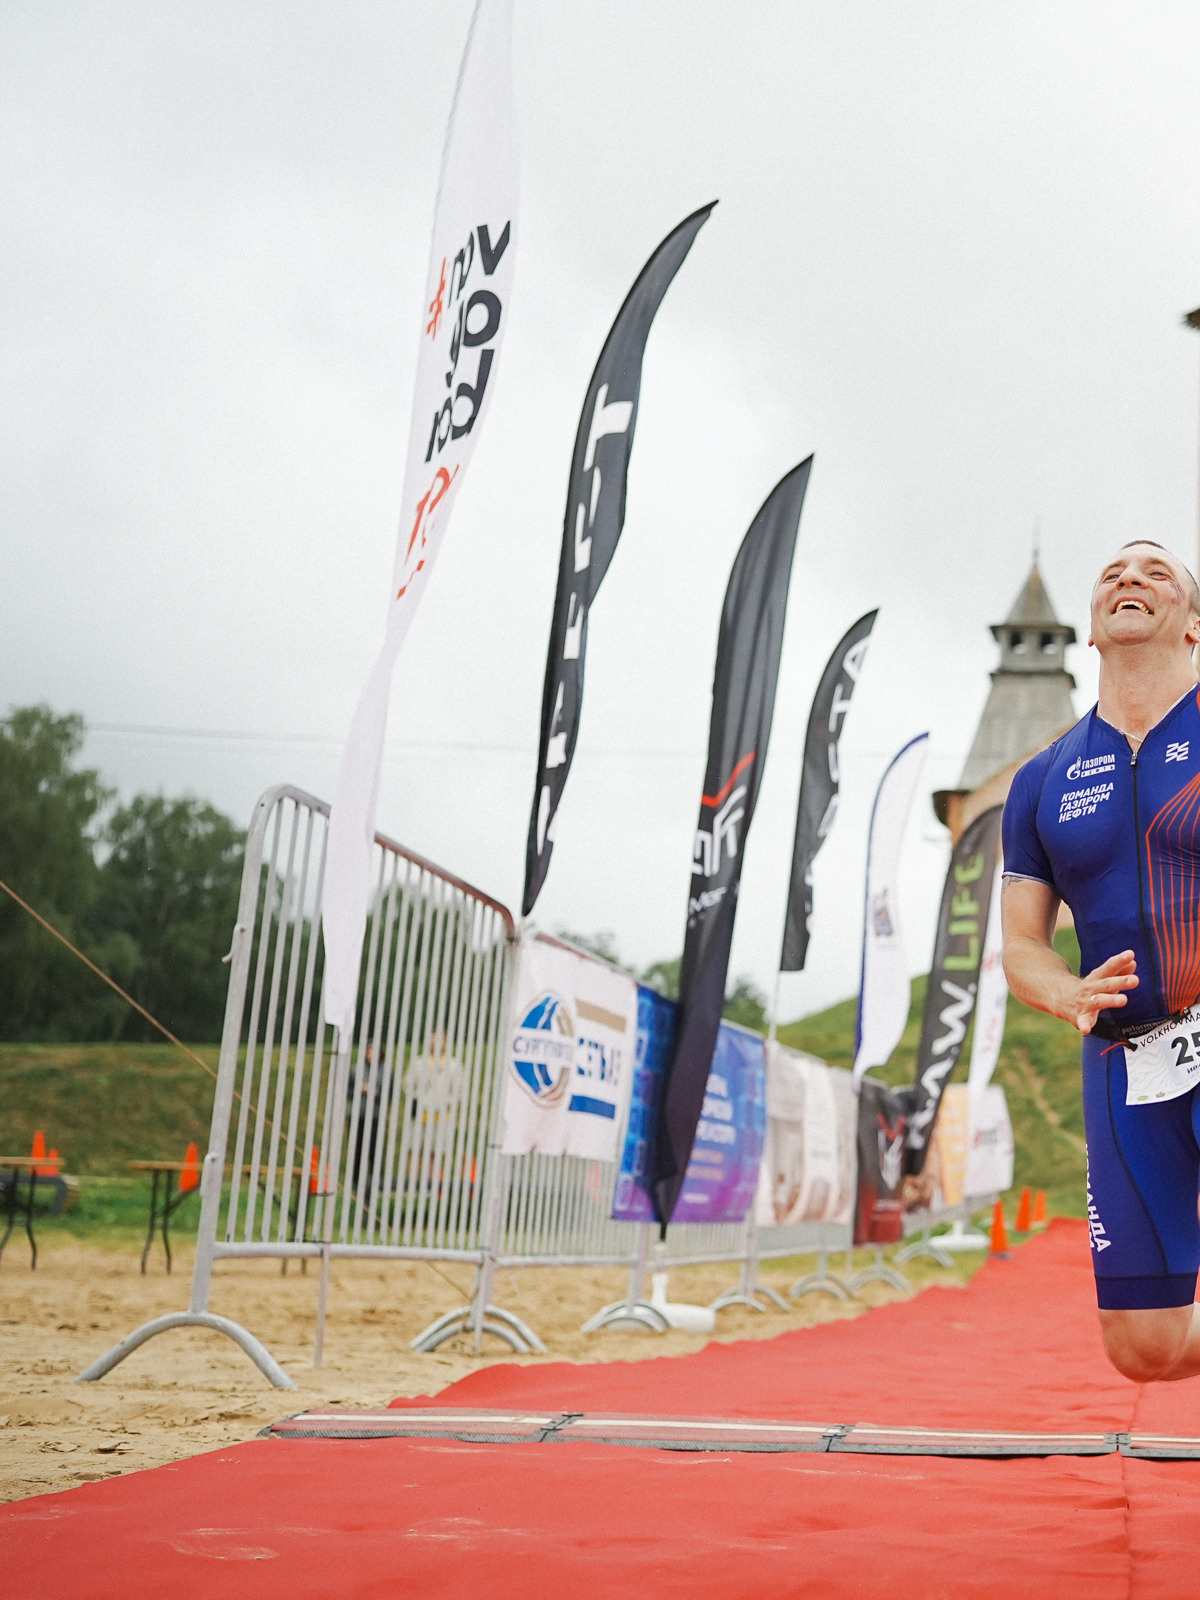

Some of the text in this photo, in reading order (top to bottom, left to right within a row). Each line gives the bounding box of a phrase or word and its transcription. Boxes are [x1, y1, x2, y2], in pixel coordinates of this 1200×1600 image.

[1081, 754, 1116, 770] ГАЗПРОМ
[1060, 792, 1111, 813] ГАЗПРОМ
[1061, 782, 1114, 803] КОМАНДА
[1058, 803, 1097, 824] НЕФТИ
